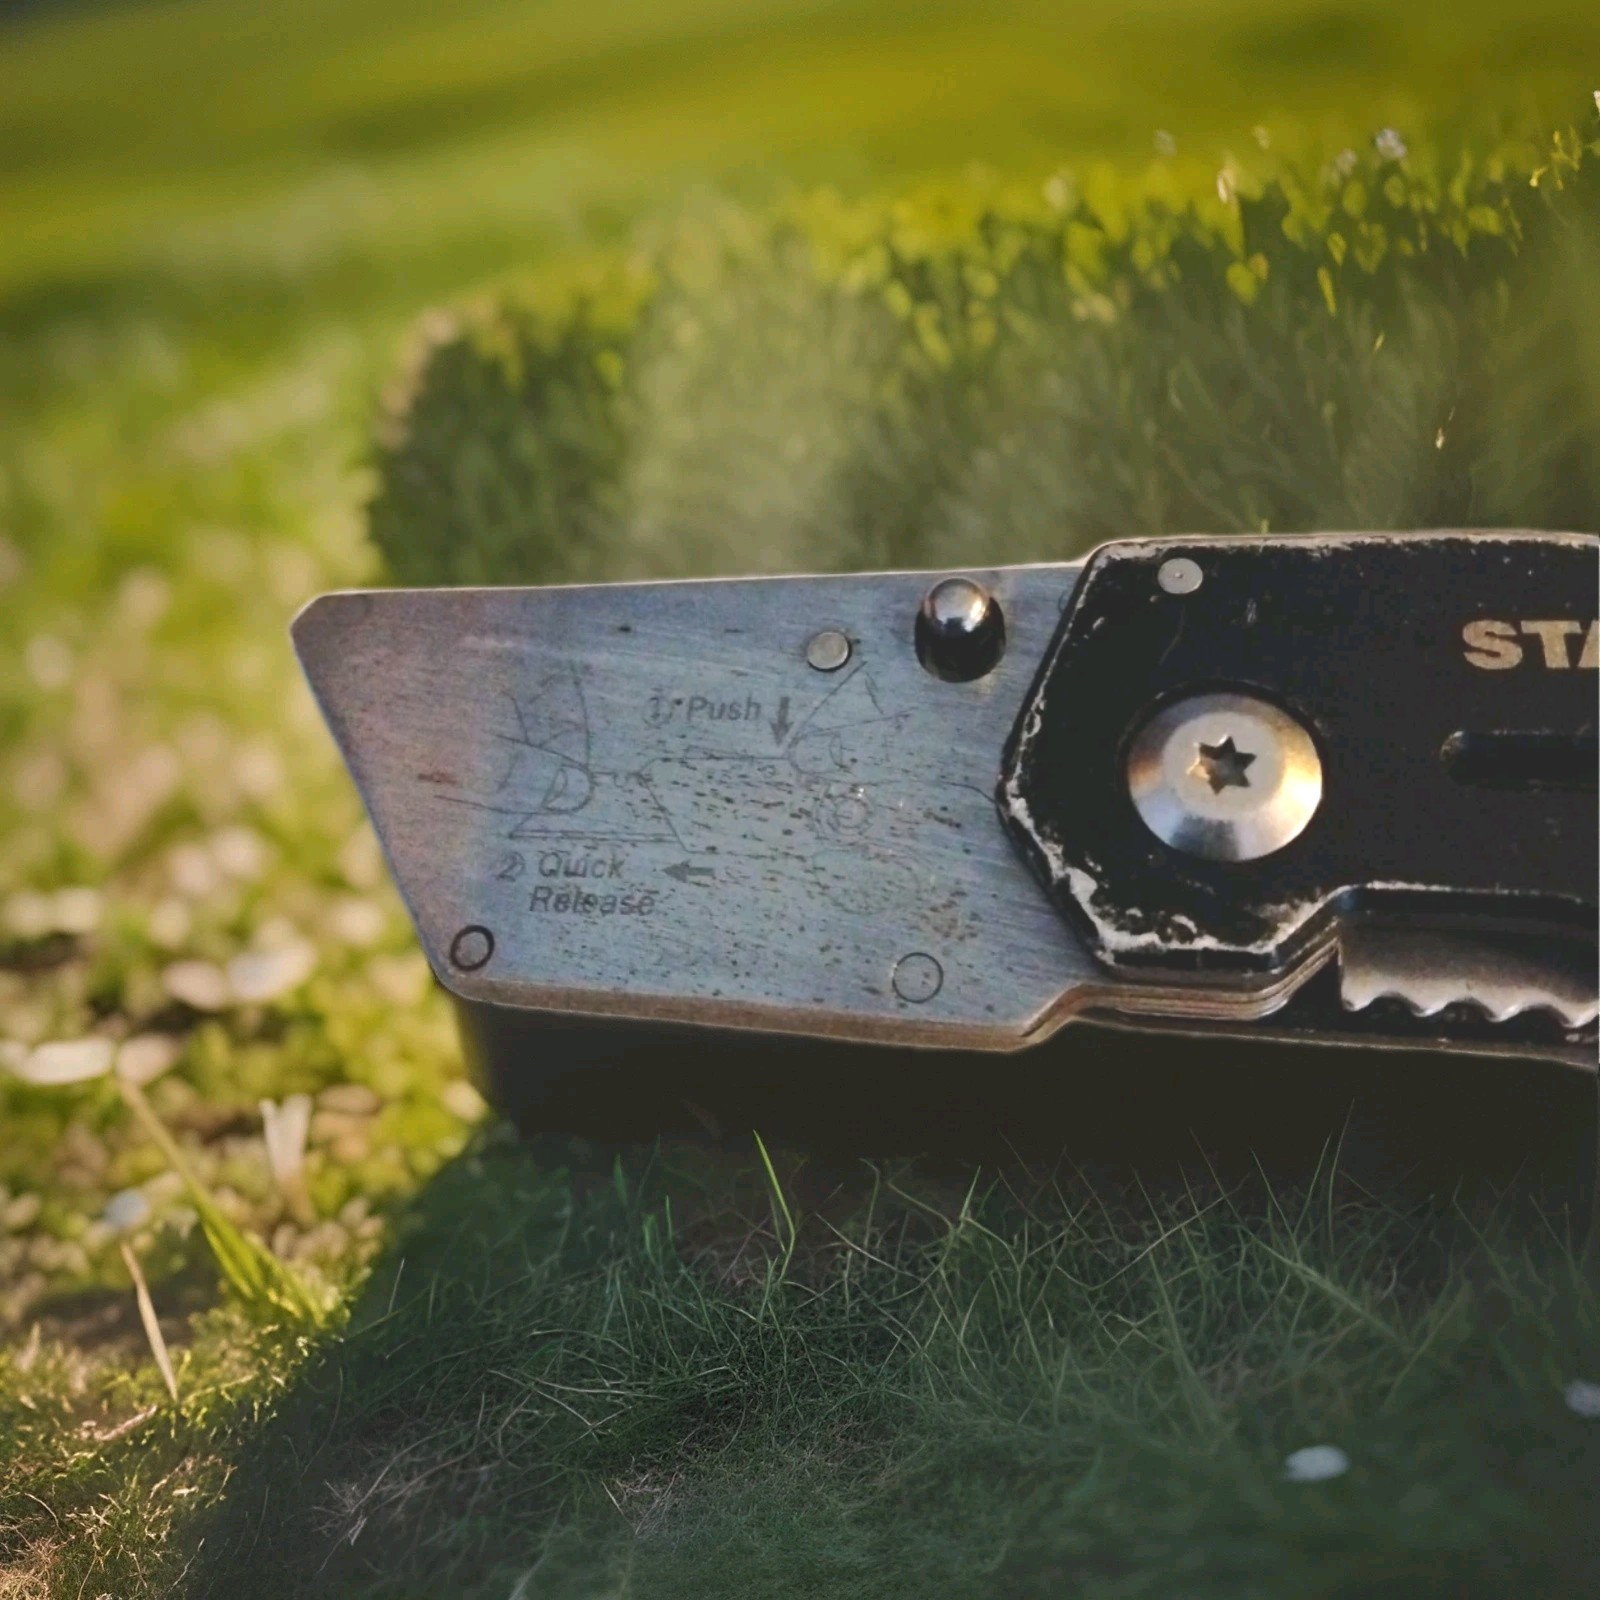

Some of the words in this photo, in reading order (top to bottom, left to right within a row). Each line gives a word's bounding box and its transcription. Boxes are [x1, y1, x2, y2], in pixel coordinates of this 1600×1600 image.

[686, 693, 763, 722] Push
[537, 850, 627, 880] Quick
[528, 885, 656, 916] Release
